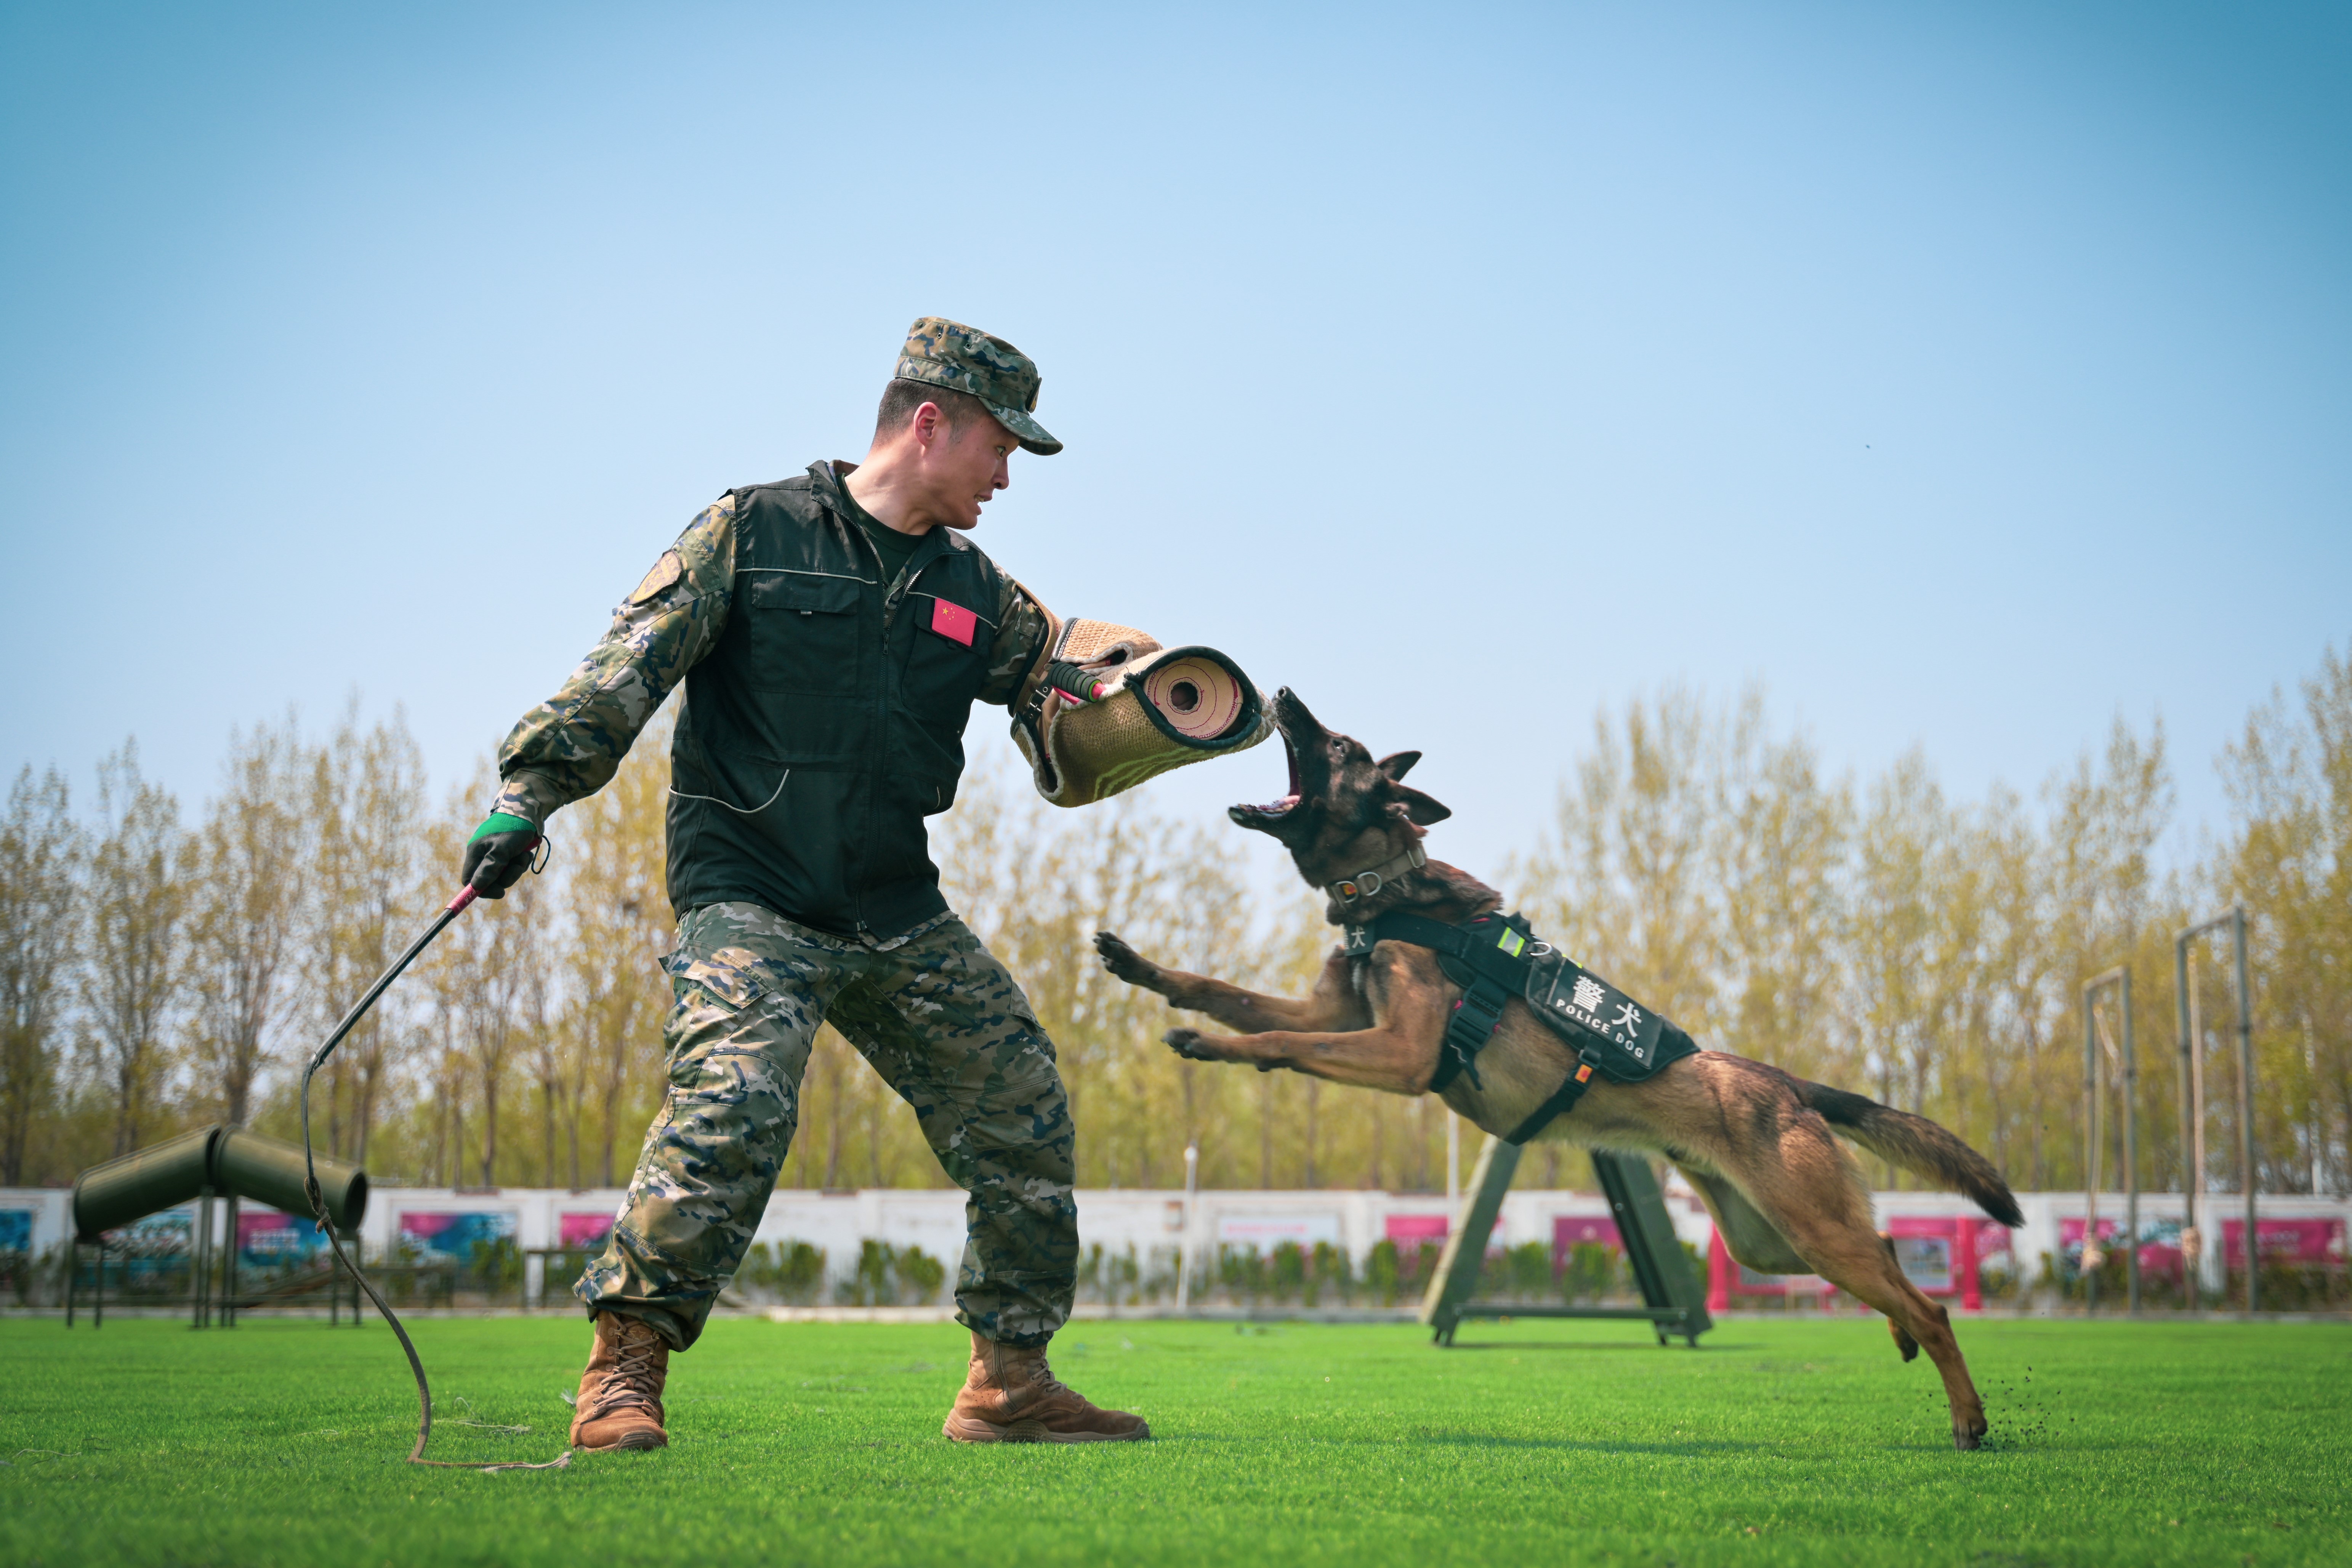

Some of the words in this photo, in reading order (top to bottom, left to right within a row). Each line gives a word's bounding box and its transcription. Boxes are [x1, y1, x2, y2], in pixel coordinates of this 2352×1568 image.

[1556, 999, 1611, 1033] POLICE
[1615, 1032, 1645, 1058] DOG
[1573, 975, 1642, 1038] 警犬
